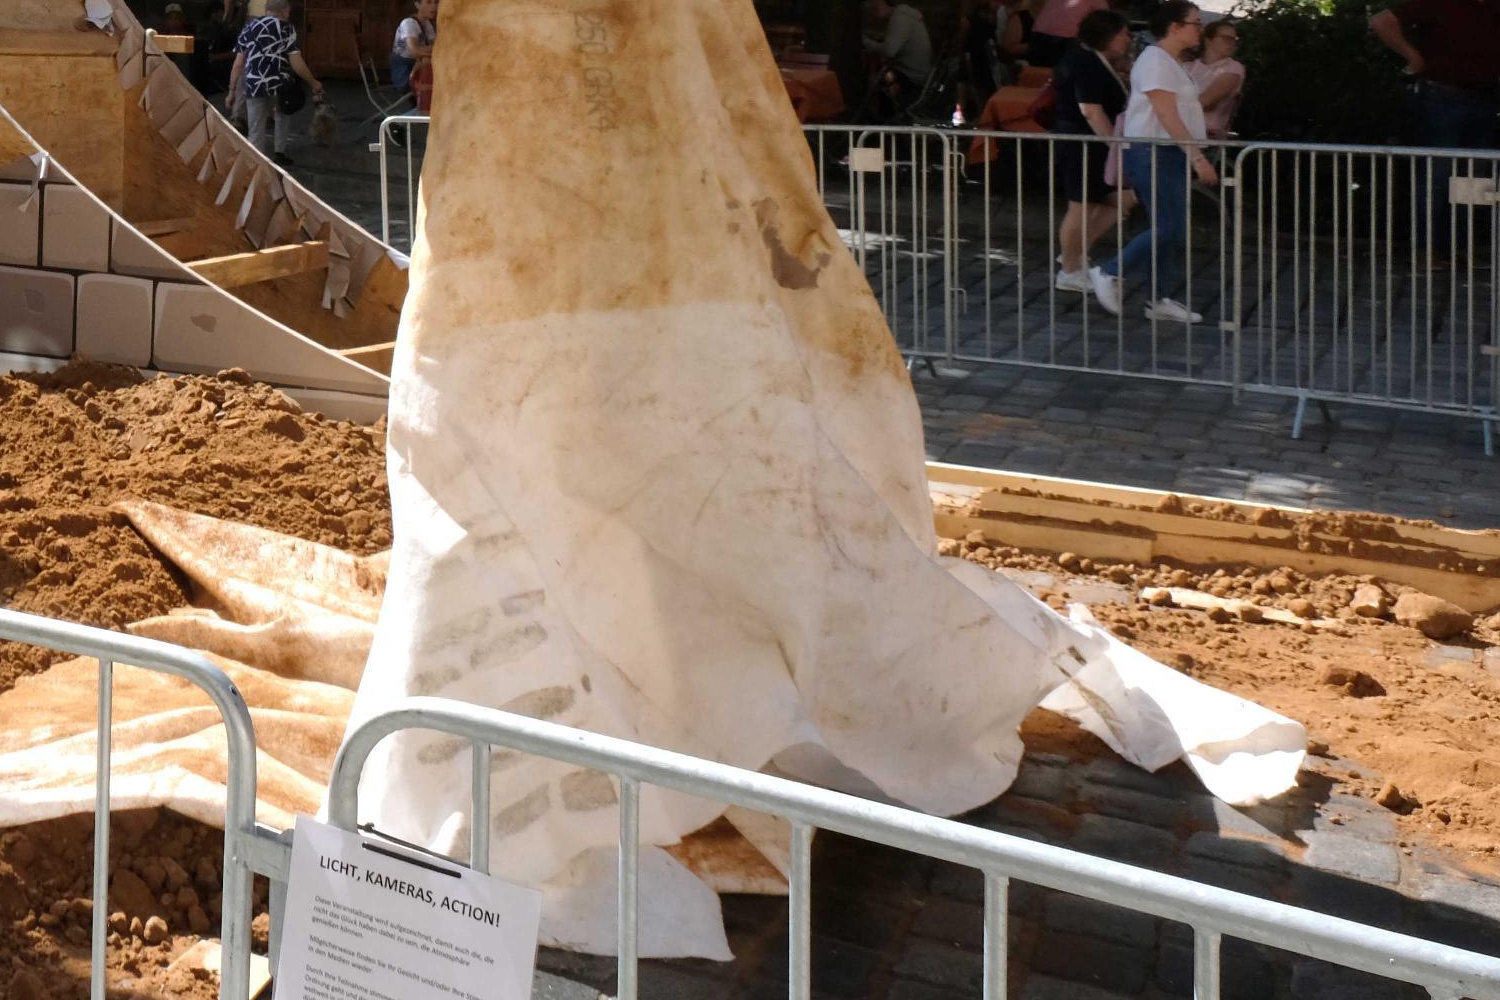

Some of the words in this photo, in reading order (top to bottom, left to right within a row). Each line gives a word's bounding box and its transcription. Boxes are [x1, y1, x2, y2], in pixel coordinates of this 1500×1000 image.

[319, 855, 361, 882] LICHT,
[365, 870, 436, 907] KAMERAS,
[440, 896, 501, 928] ACTION!
